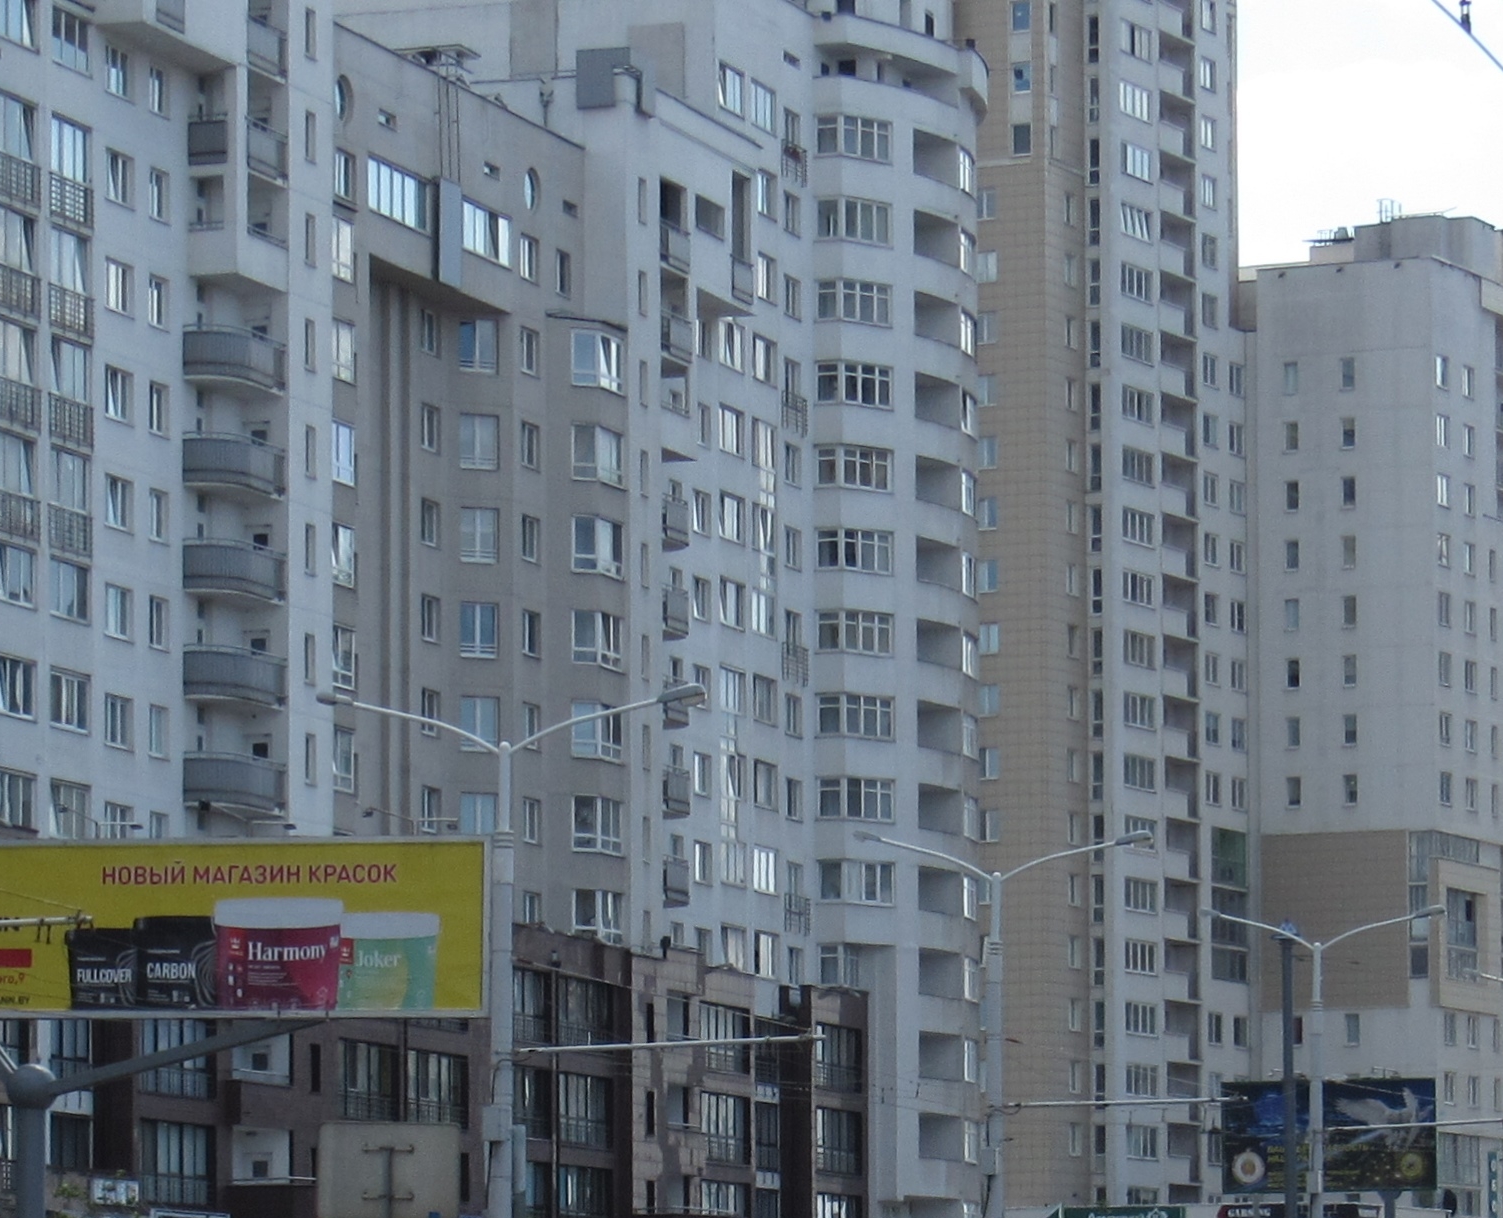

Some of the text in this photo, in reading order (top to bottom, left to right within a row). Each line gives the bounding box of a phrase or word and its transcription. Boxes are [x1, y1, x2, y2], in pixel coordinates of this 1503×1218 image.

[101, 861, 397, 885] НОВЫЙ МАГАЗИН КРАСОК
[247, 941, 327, 964] Harmony
[355, 951, 401, 968] Joker
[76, 968, 132, 984] FULLCOVER
[146, 962, 197, 979] CARBON
